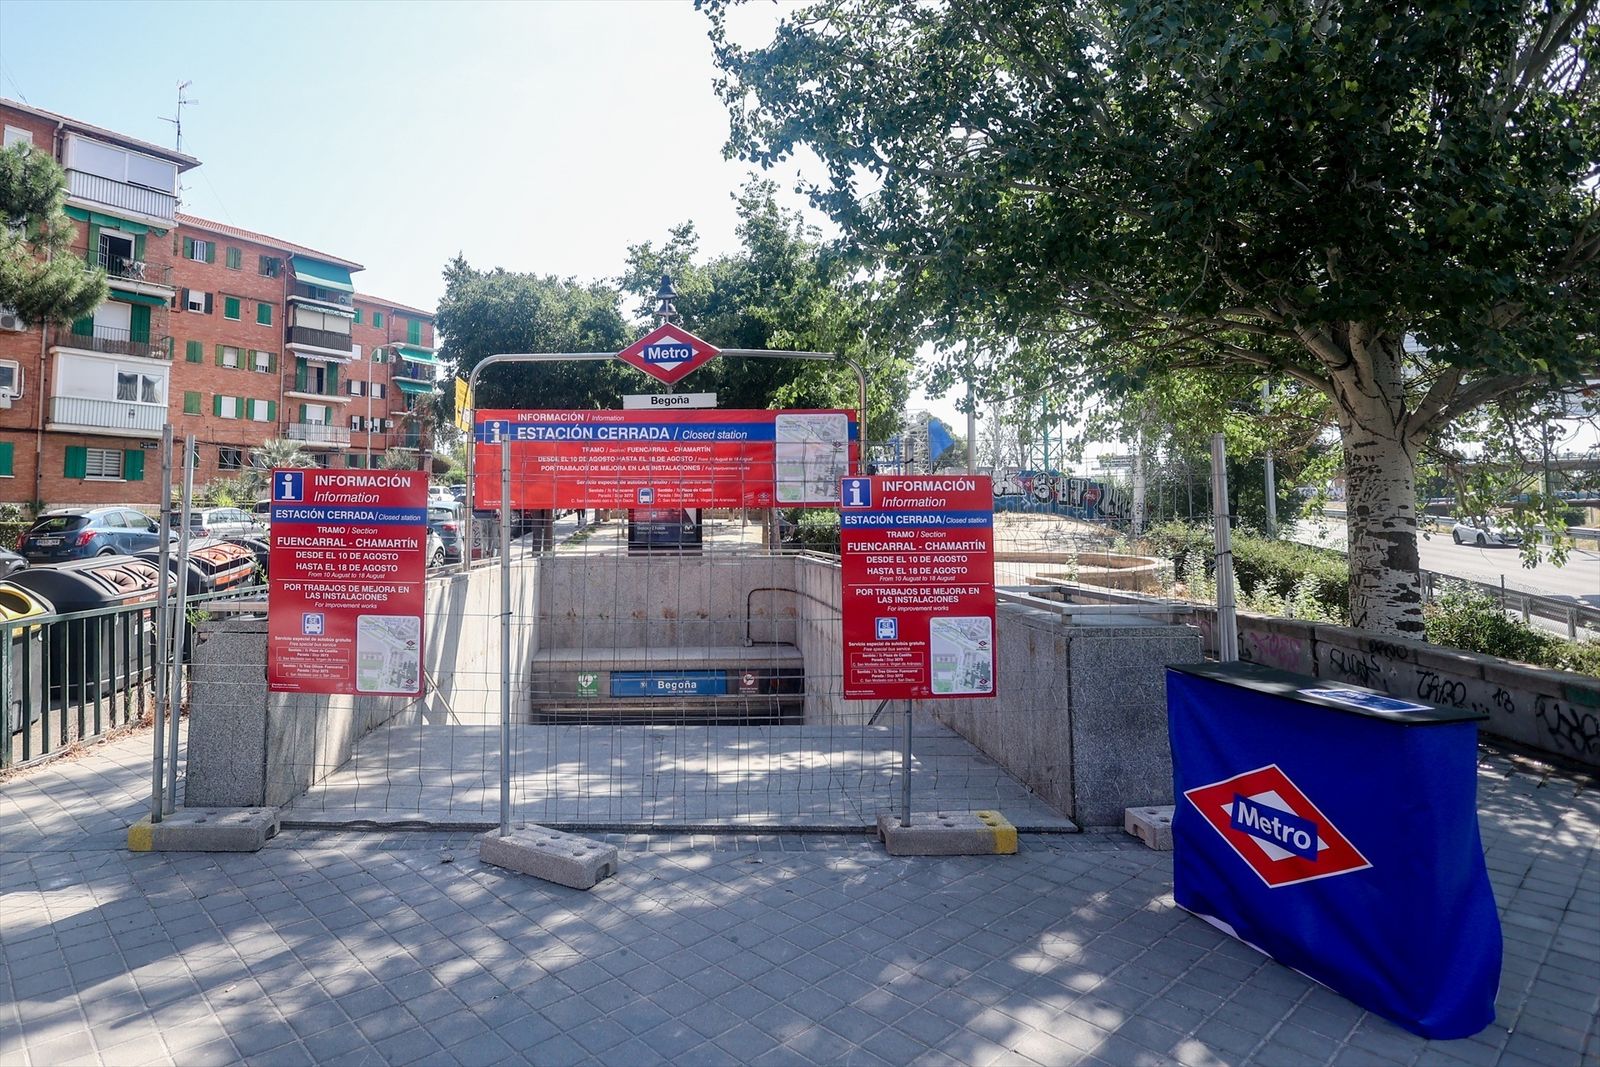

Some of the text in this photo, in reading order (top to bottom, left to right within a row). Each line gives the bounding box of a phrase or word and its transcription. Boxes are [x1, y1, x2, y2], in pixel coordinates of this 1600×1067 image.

[648, 347, 689, 360] Metro
[651, 396, 690, 406] Begoña
[518, 412, 584, 422] INFORMACIÓN
[592, 414, 624, 422] Information
[518, 424, 592, 440] ESTACIÓN
[597, 427, 670, 440] CERRADA
[682, 430, 716, 440] Closed
[716, 430, 748, 440] station
[314, 474, 411, 488] INFORMACIÓN
[882, 478, 976, 492] INFORMACIÓN
[314, 492, 380, 502] Information
[882, 496, 946, 508] Information
[276, 508, 324, 520] ESTACIÓN
[845, 514, 893, 524] ESTACIÓN
[317, 526, 346, 534] TRAMO
[351, 527, 378, 535] Section
[277, 537, 346, 547] FUENCARRAL
[356, 537, 418, 548] CHAMARTÍN
[848, 542, 916, 551] FUENCARRAL
[925, 539, 986, 550] CHAMARTÍN
[362, 564, 398, 572] AGOSTO
[303, 584, 346, 592] TRABAJOS
[349, 584, 359, 592] DE
[323, 592, 388, 600] INSTALACIONES
[658, 681, 697, 690] Begoña
[1238, 802, 1312, 850] Metro
